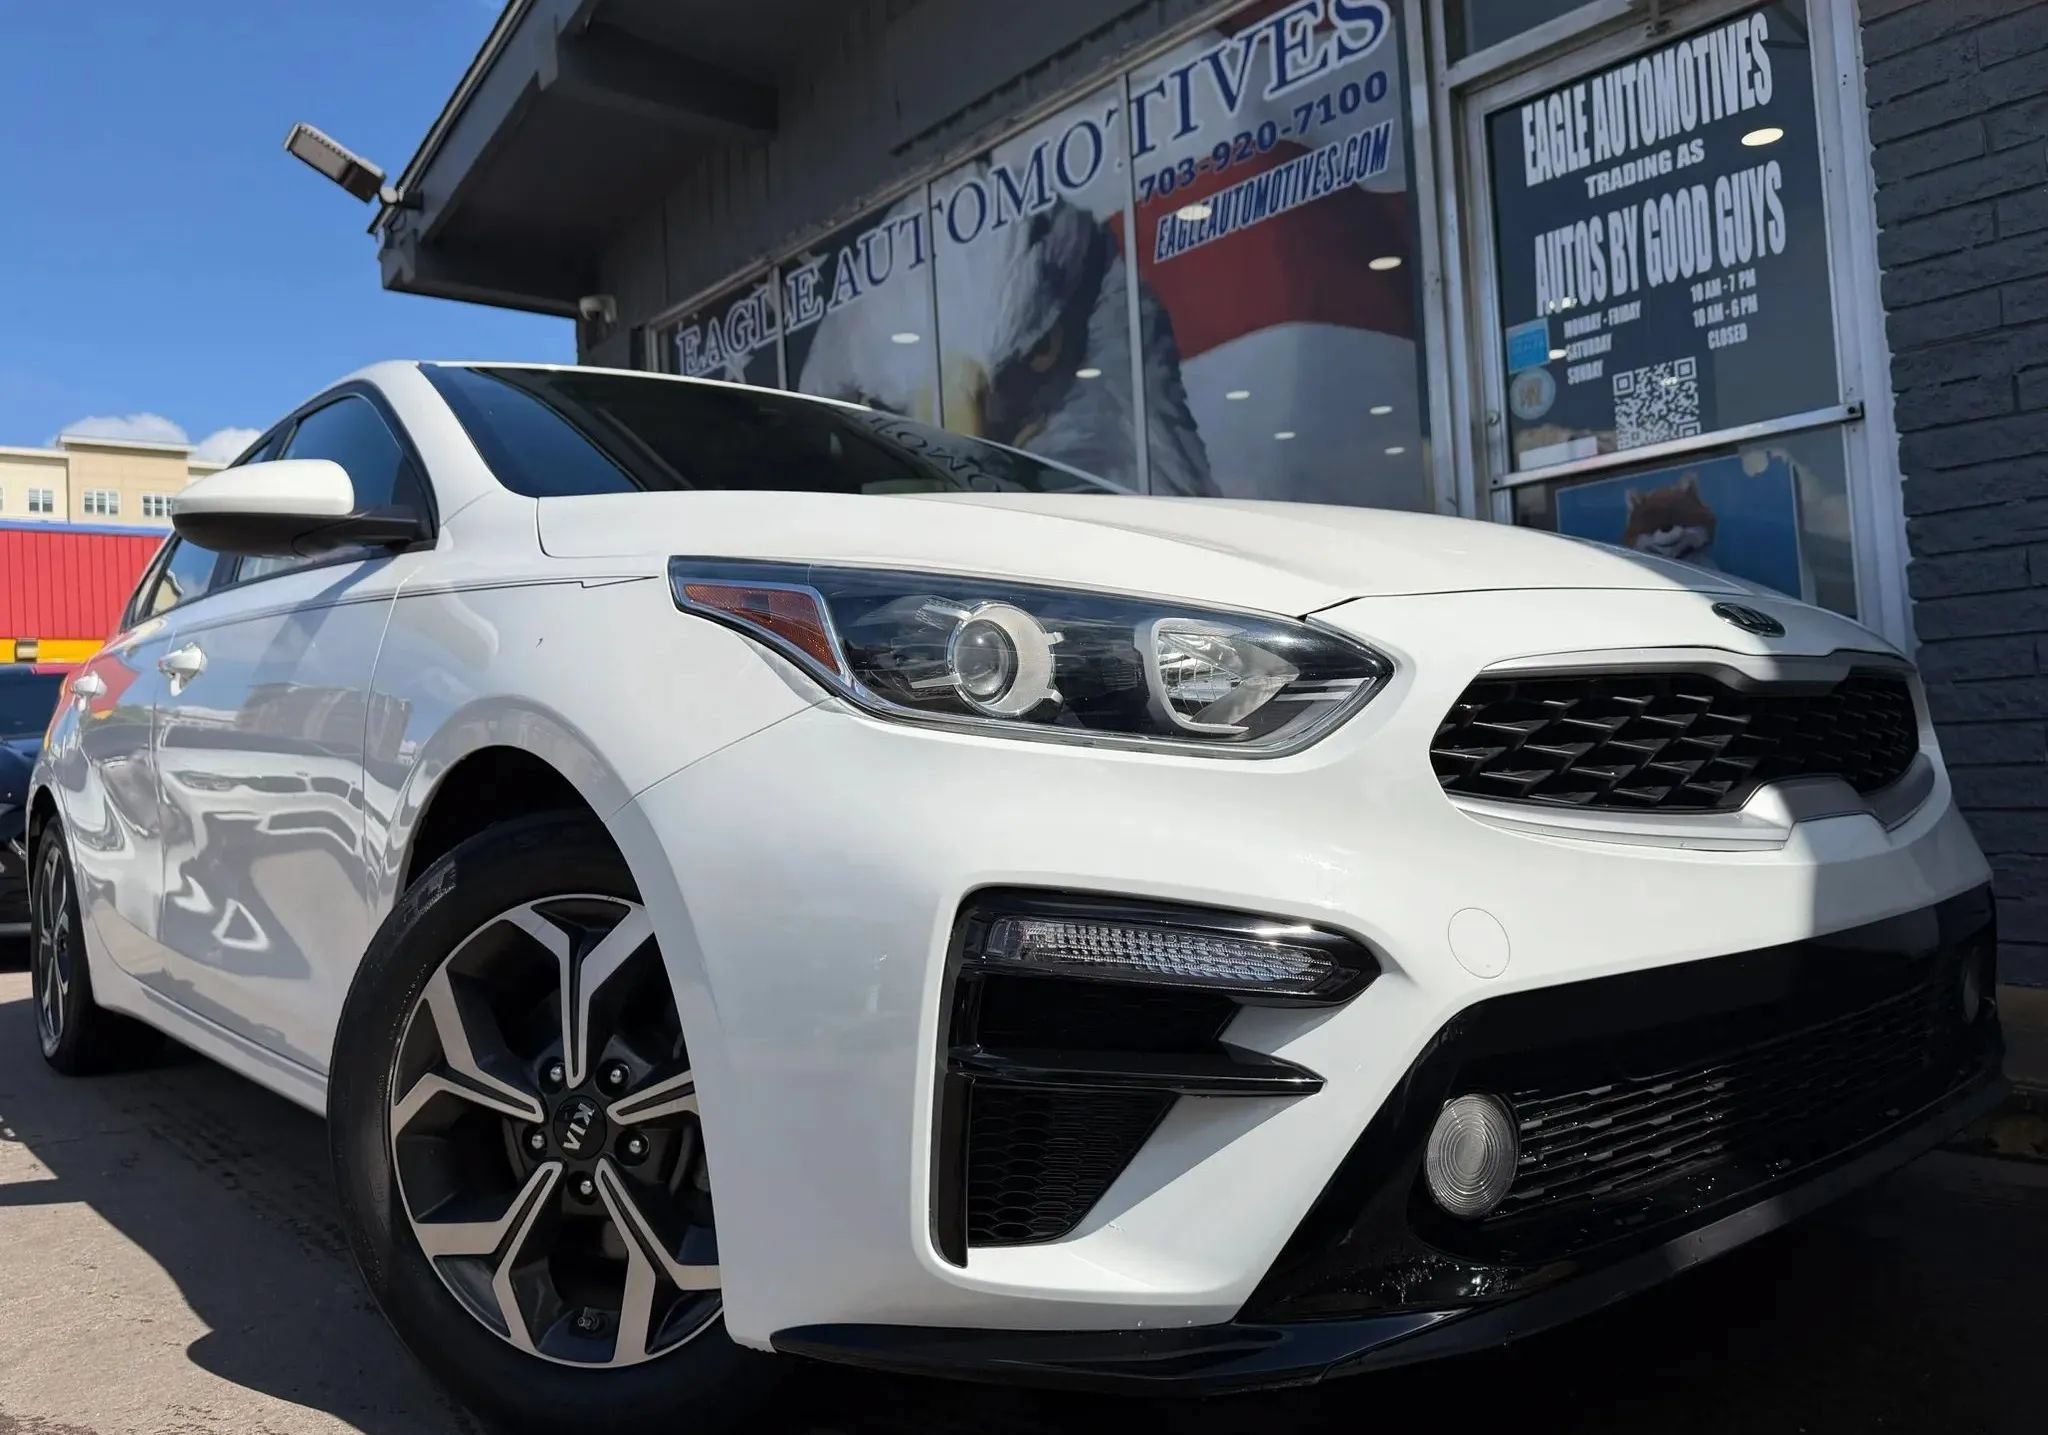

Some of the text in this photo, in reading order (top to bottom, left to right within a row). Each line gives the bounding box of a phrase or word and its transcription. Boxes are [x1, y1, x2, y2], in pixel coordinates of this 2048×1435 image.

[1139, 70, 1389, 202] 703-920-7100
[1522, 12, 1772, 187] EAGLE AUTOMOTIVES
[676, 0, 1392, 377] EAGLE AUTOMOTIVES
[1153, 118, 1394, 264] EAGLEAUTOMOTIVES.COM
[1585, 139, 1705, 198] TRADING AS
[1535, 160, 1786, 317] AUTOS BY GOOD GUYS
[1690, 282, 1704, 304] 10
[1738, 267, 1756, 290] PM
[1692, 307, 1706, 328] 10
[1740, 293, 1759, 315] PM
[1707, 322, 1748, 349] CLOSED
[563, 1102, 595, 1150] KIA
